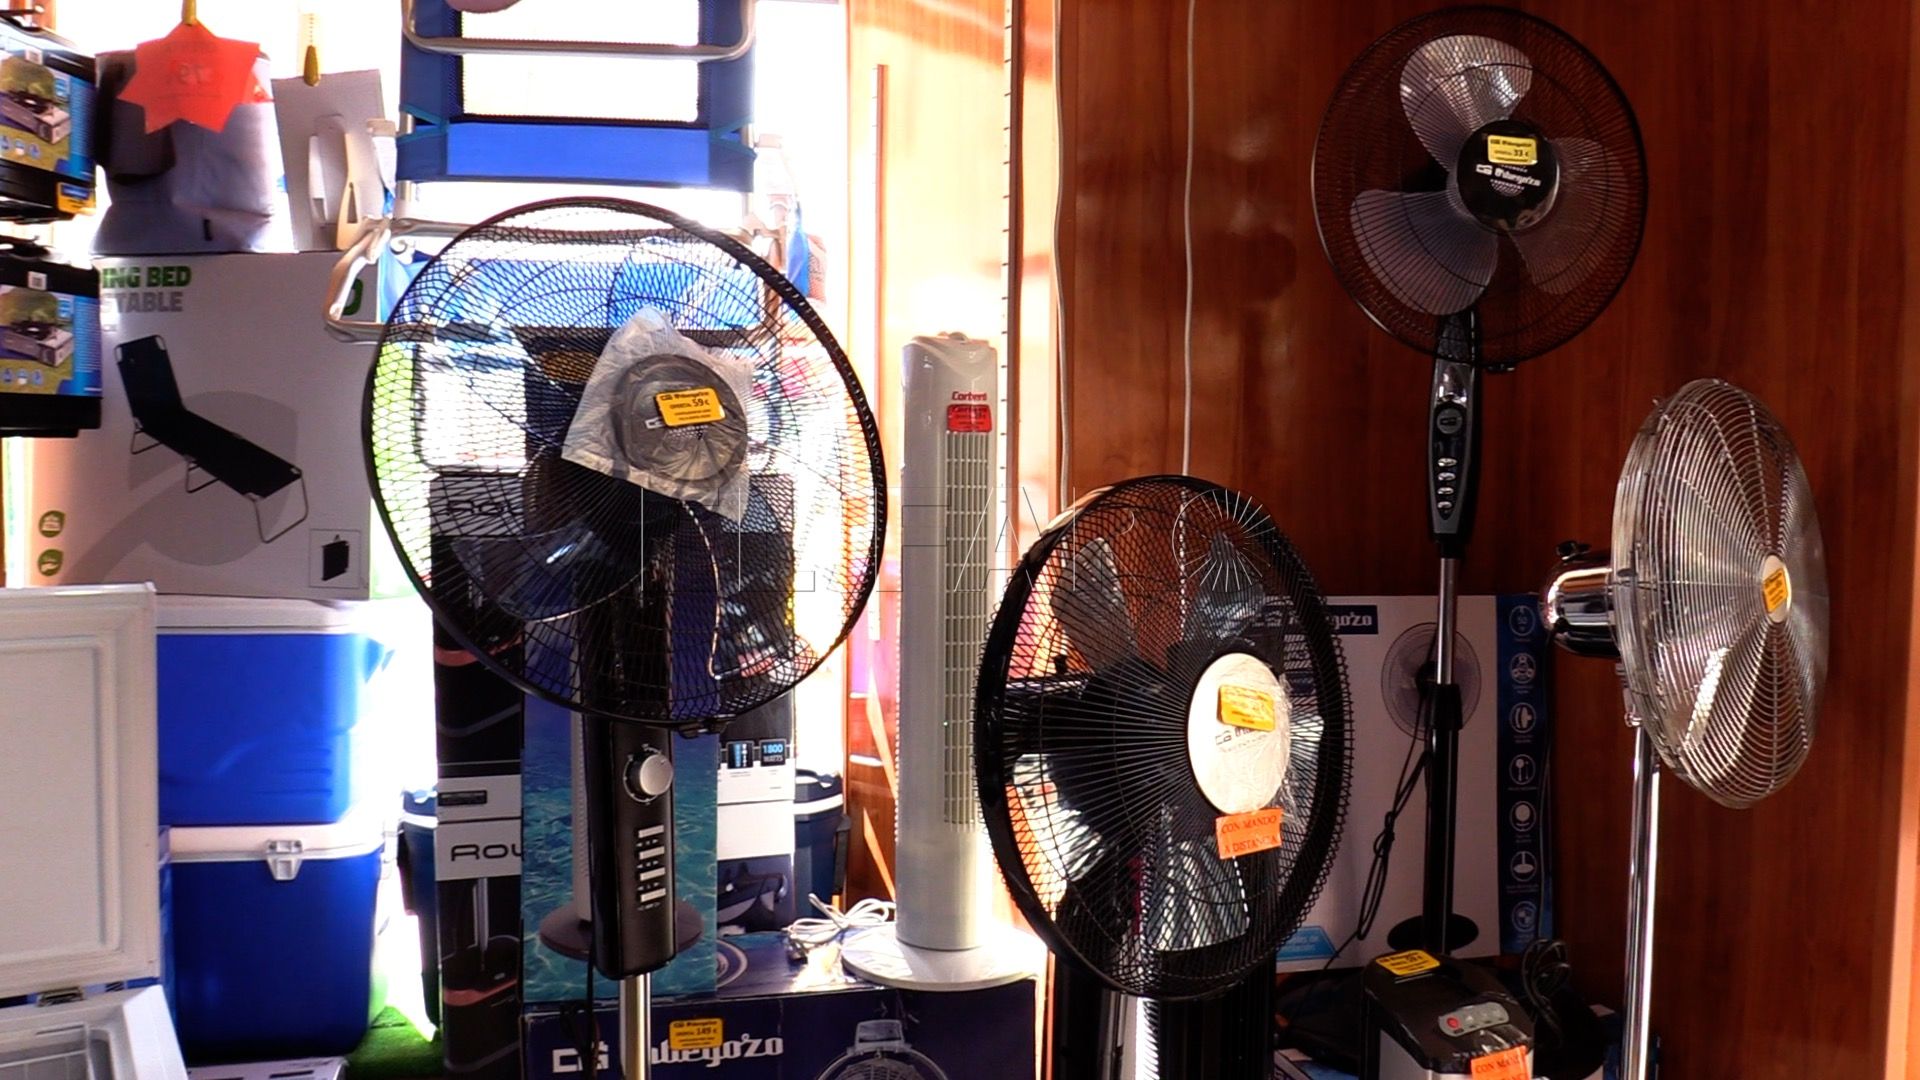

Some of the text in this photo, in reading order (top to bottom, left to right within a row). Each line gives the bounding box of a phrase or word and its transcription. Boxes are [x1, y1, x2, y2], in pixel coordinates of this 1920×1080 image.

[146, 266, 191, 288] BED
[692, 398, 704, 407] 59
[762, 743, 784, 754] 1800
[1221, 815, 1277, 834] CON MANDO
